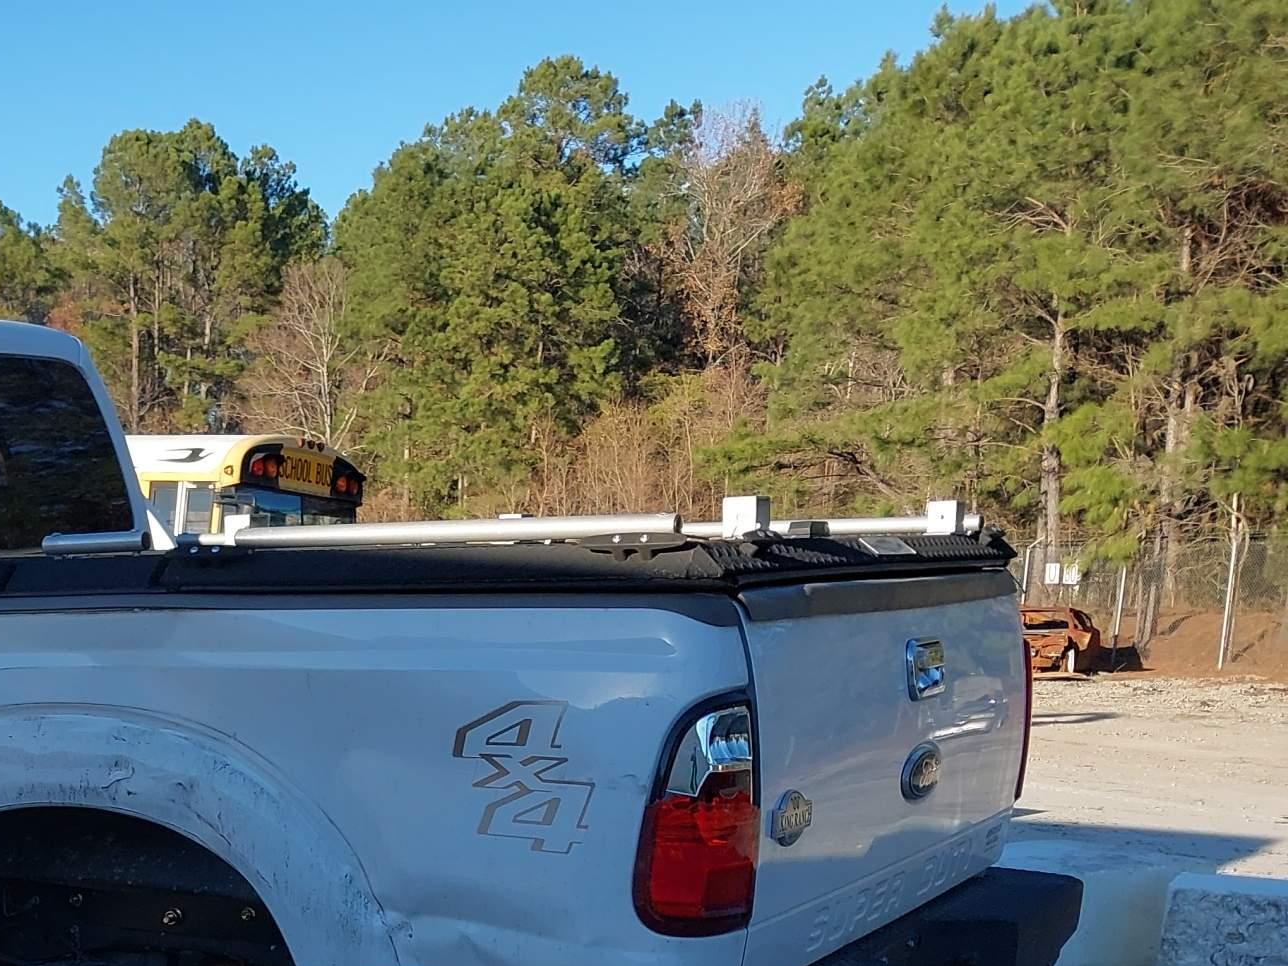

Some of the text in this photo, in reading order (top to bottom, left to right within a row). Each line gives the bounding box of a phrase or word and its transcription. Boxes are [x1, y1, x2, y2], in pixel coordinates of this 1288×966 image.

[279, 455, 333, 487] SCHOOL BUS
[805, 868, 907, 954] SUPER
[916, 836, 973, 897] DUTY
